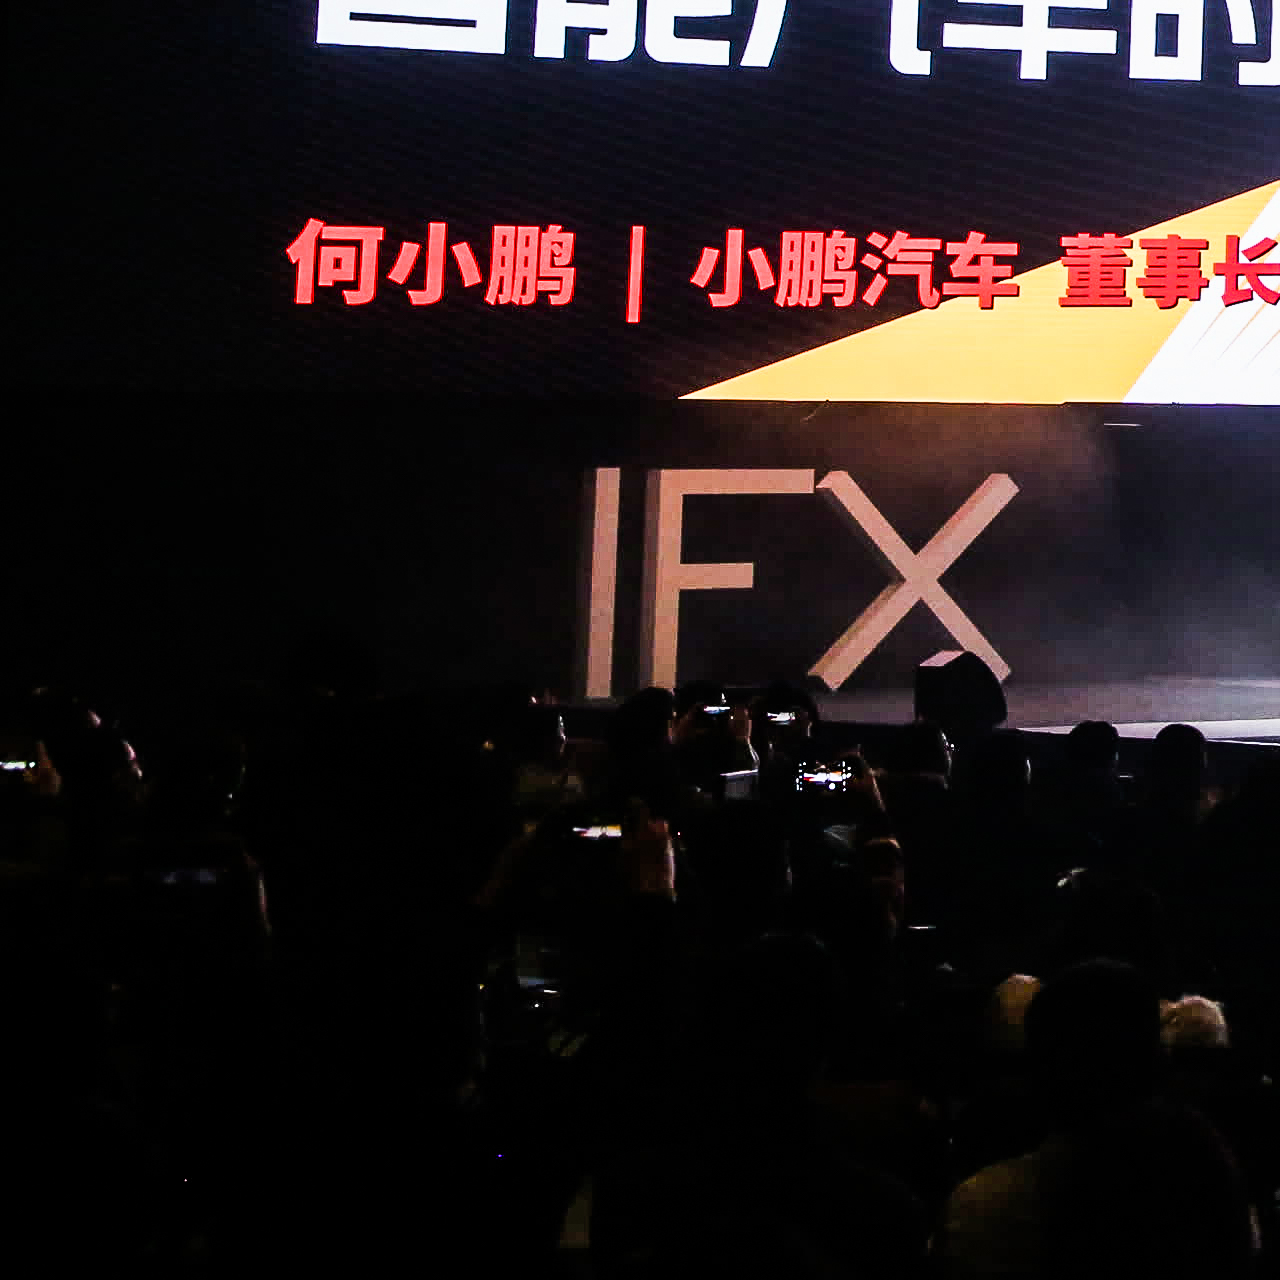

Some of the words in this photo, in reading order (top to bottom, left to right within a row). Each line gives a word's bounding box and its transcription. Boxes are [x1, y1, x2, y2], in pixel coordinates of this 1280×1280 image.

[286, 218, 577, 306] 何小鹏
[690, 228, 1020, 310] 小鹏汽车
[584, 467, 1020, 699] IFX
